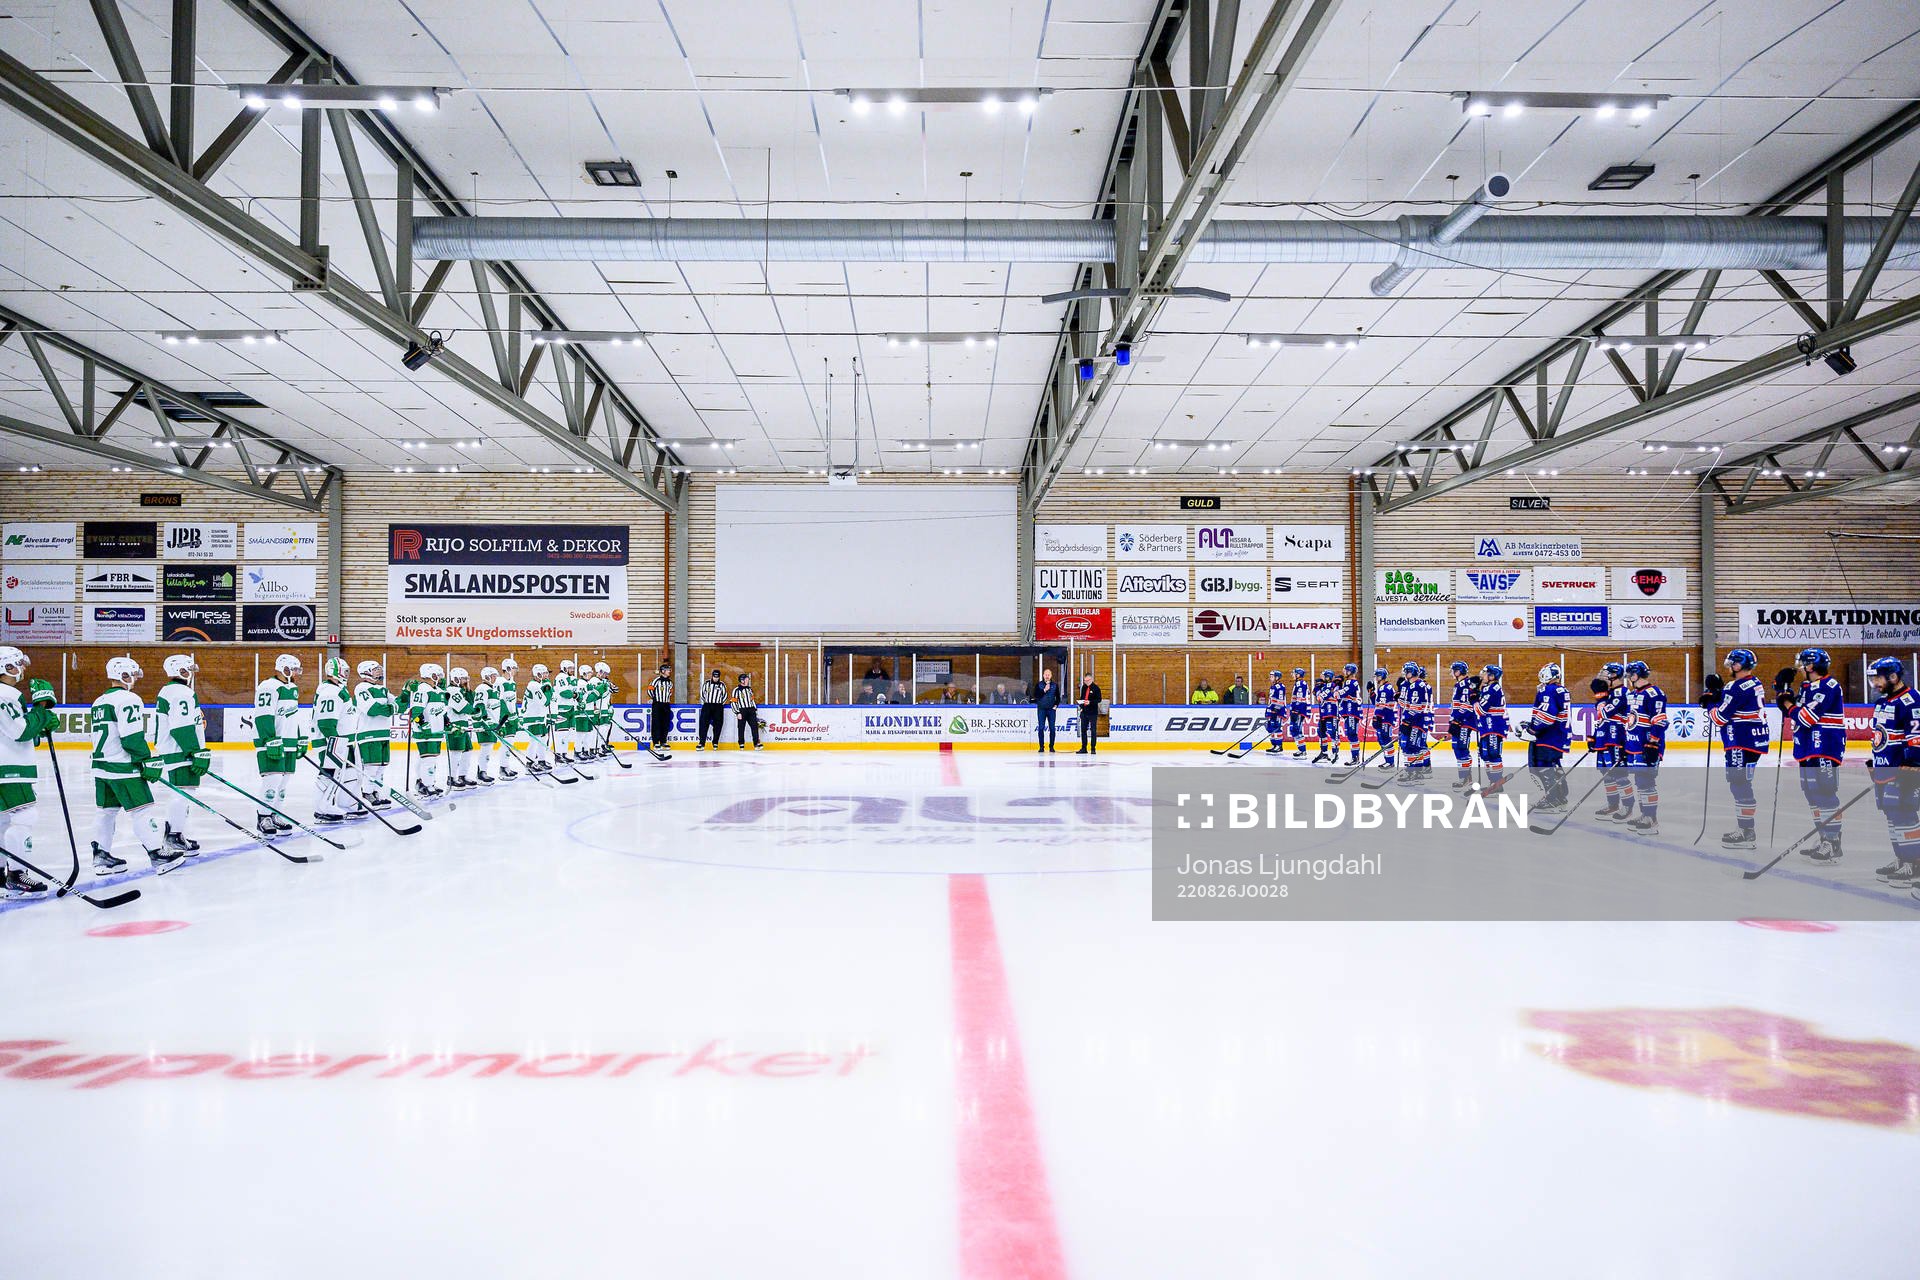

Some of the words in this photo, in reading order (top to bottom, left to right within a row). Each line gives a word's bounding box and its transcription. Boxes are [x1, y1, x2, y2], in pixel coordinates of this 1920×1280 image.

[144, 496, 179, 505] BRONS
[1187, 499, 1214, 508] GULD
[1511, 500, 1549, 508] SILVER
[51, 537, 74, 545] Energi
[166, 527, 202, 549] JPB
[248, 536, 314, 545] SMÅLANDSIDROTTEN
[1139, 533, 1183, 545] Söderberg
[1199, 527, 1234, 548] ALT
[1284, 534, 1332, 551] Scapa
[425, 537, 465, 554] RIJO
[469, 538, 543, 553] SOLFILM
[547, 539, 559, 553] &
[563, 539, 622, 553] DEKOR
[1045, 543, 1103, 554] Trädgårdsdesign
[1138, 544, 1146, 552] &
[110, 573, 130, 582] FBR
[404, 569, 610, 594] SMÅLANDSPOSTEN
[1040, 569, 1103, 589] CUTTING
[1385, 569, 1414, 583] SÅG
[1631, 575, 1667, 584] GEHAB
[257, 582, 288, 592] Allbo
[1120, 575, 1187, 593] Atteviks
[1200, 578, 1233, 592] GBJ
[1479, 574, 1508, 590] AVS
[1542, 581, 1596, 589] SVETRUCK
[1385, 583, 1438, 595] MASKIN
[1061, 590, 1102, 600] SOLUTIONS
[1413, 592, 1451, 602] service
[168, 609, 231, 619] wellness
[569, 610, 611, 620] Swedbank
[1048, 608, 1071, 616] ALVESTA
[1541, 612, 1602, 621] ABETONG
[280, 616, 308, 626] AFM
[396, 614, 417, 624] Stolt
[419, 615, 455, 625] sponsor
[456, 616, 467, 624] av
[1122, 615, 1181, 624] FÄLTSTRÖMS
[1222, 614, 1267, 631] VIDA
[1379, 618, 1445, 626] Handelsbanken
[1063, 621, 1090, 630] BDS
[1272, 622, 1341, 630] BILLAFRAKT
[396, 626, 442, 638] Alvesta
[446, 627, 463, 638] SK
[466, 626, 573, 641] Ungdomssektion
[1757, 626, 1796, 639] VÄXJÖ
[1800, 627, 1851, 639] ALVESTA
[1860, 629, 1874, 640] Din
[1876, 628, 1901, 639] lokala
[259, 693, 271, 707] 57
[413, 692, 423, 703] 61
[180, 701, 189, 715] 3
[320, 700, 335, 713] 70
[781, 708, 811, 724] ICA
[865, 716, 942, 727] KLONDYKE
[768, 723, 829, 735] Supermarket
[970, 719, 985, 728] BR.
[987, 719, 1029, 729] J-SKROT
